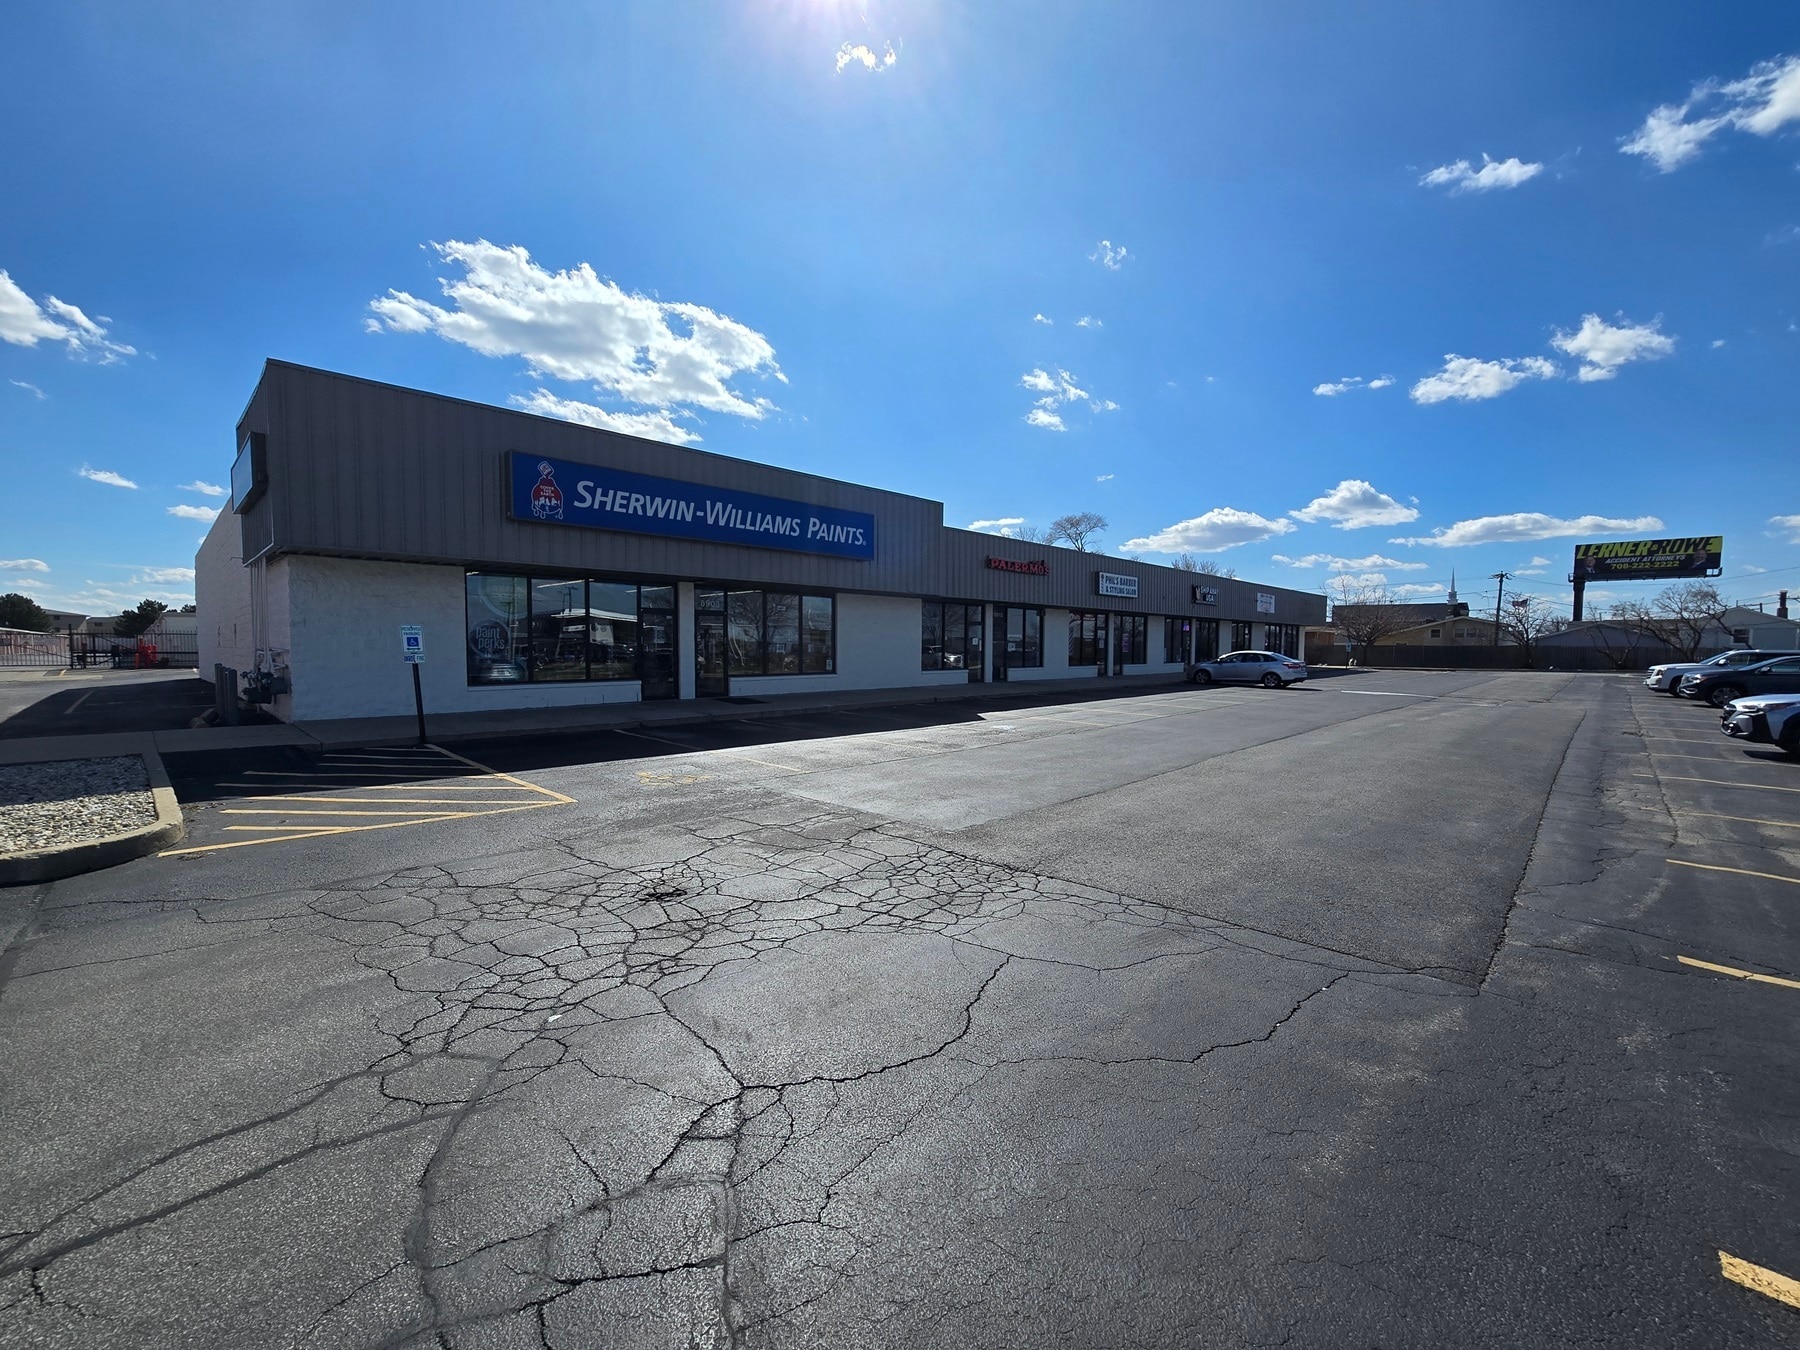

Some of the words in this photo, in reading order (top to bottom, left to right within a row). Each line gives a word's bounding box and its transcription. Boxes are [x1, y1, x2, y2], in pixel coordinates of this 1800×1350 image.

[574, 480, 801, 537] SHERWIN-WILLIAMS
[806, 517, 864, 546] PAINTS
[1576, 541, 1650, 560] LERNER
[1605, 556, 1641, 564] ACCIDENT
[1642, 554, 1686, 563] ATTORNEYS
[1611, 560, 1680, 570] 708-222-2222
[1120, 577, 1137, 588] BARBER
[1125, 588, 1137, 596] SALON
[700, 600, 720, 608] 8903
[477, 627, 500, 639] paint
[478, 638, 505, 649] perks
